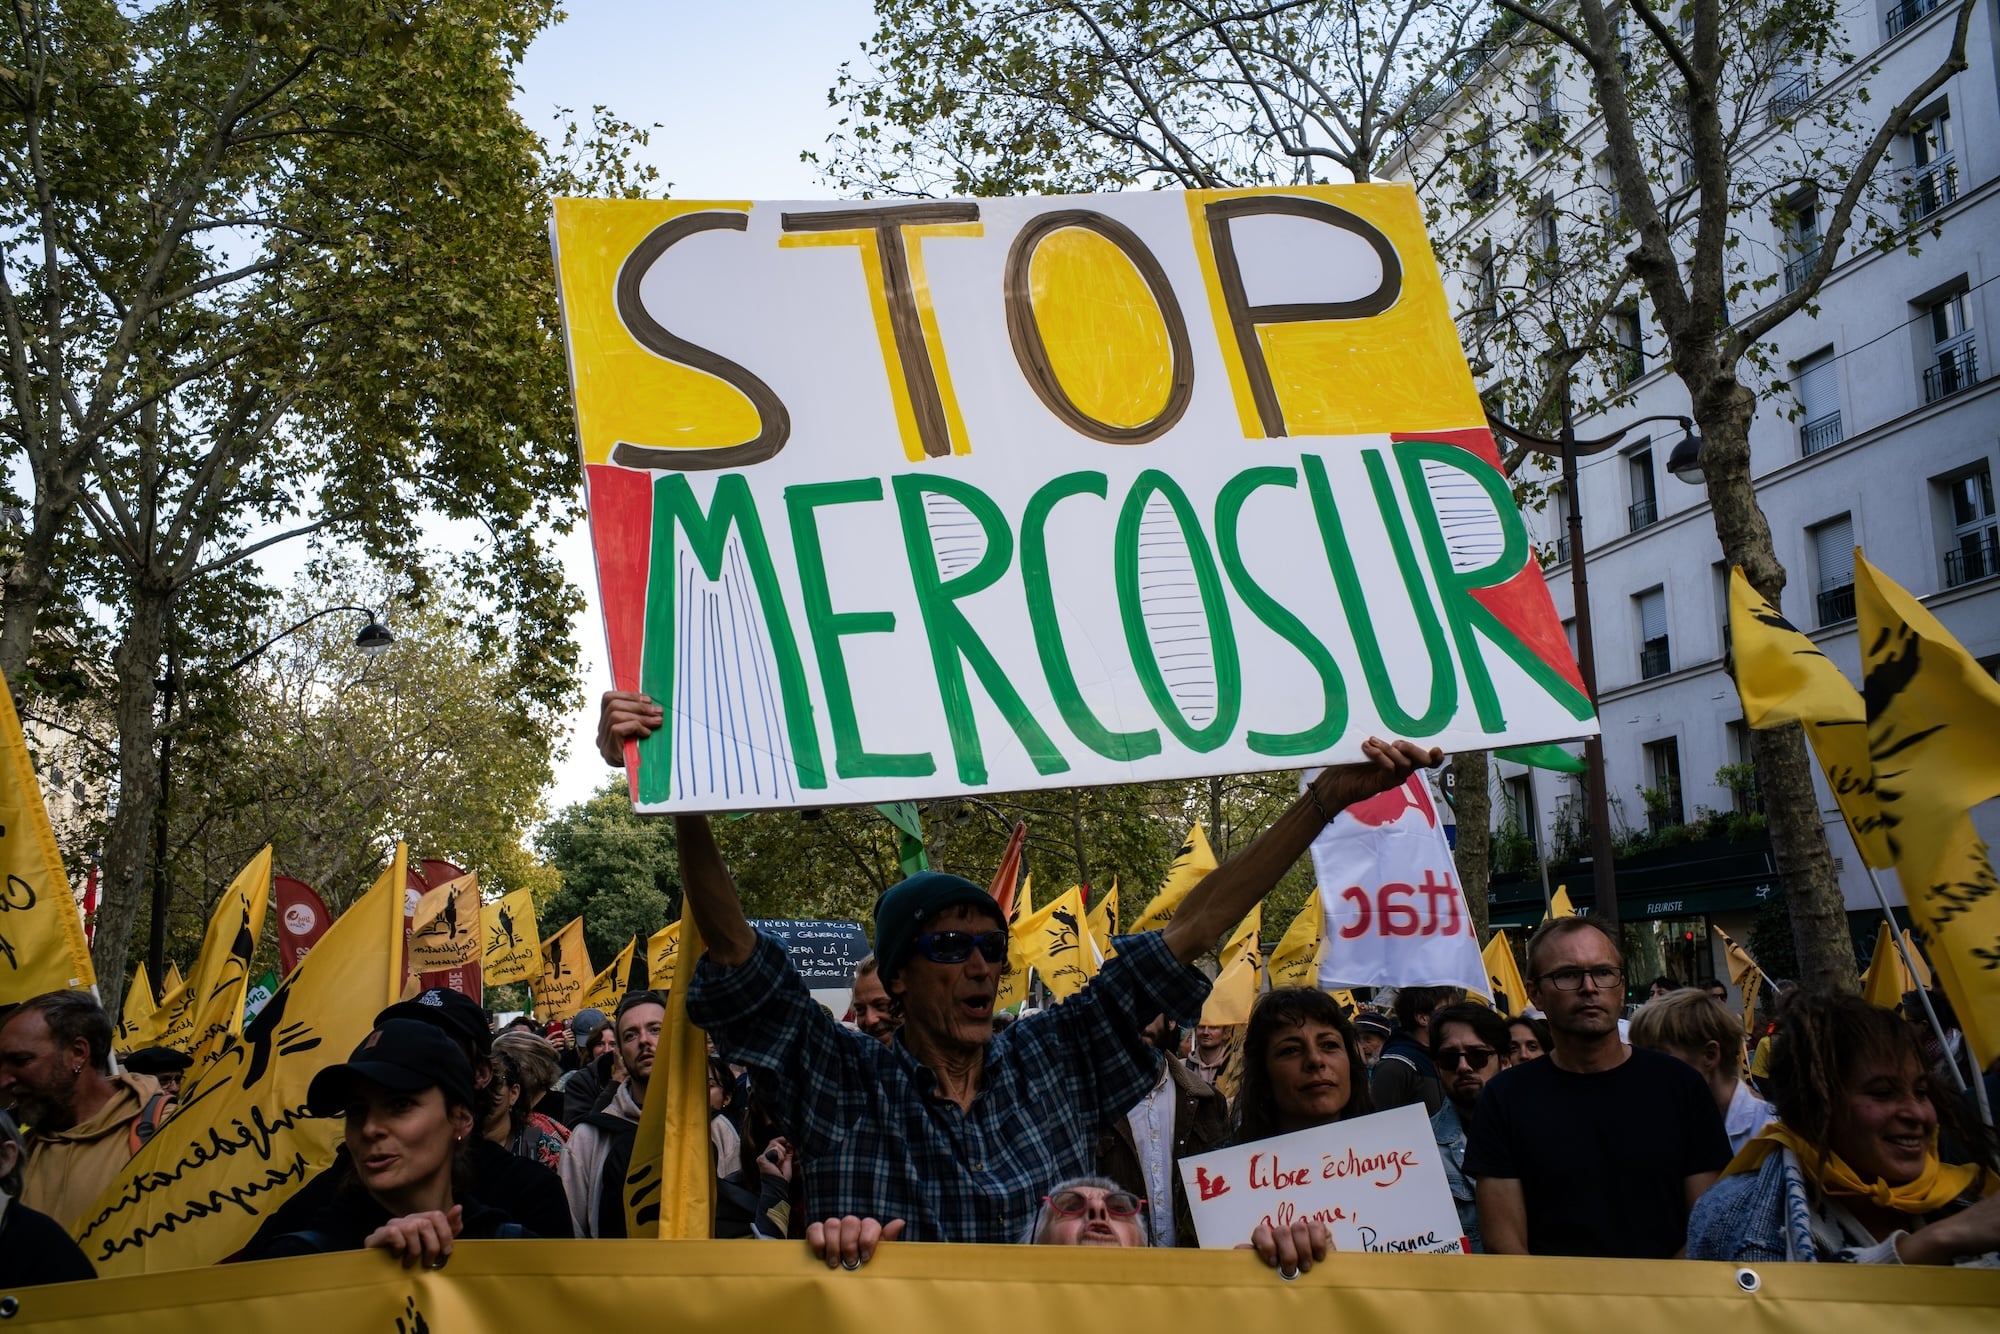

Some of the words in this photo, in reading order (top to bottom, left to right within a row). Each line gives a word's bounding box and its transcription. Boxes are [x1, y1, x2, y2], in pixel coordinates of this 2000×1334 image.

[616, 197, 1402, 470] STOP
[639, 440, 1597, 805] MERCOSUR
[1647, 901, 1683, 914] FLEURISTE
[765, 920, 789, 928] N'EN
[788, 945, 814, 954] SERA
[1322, 1148, 1418, 1187] échange
